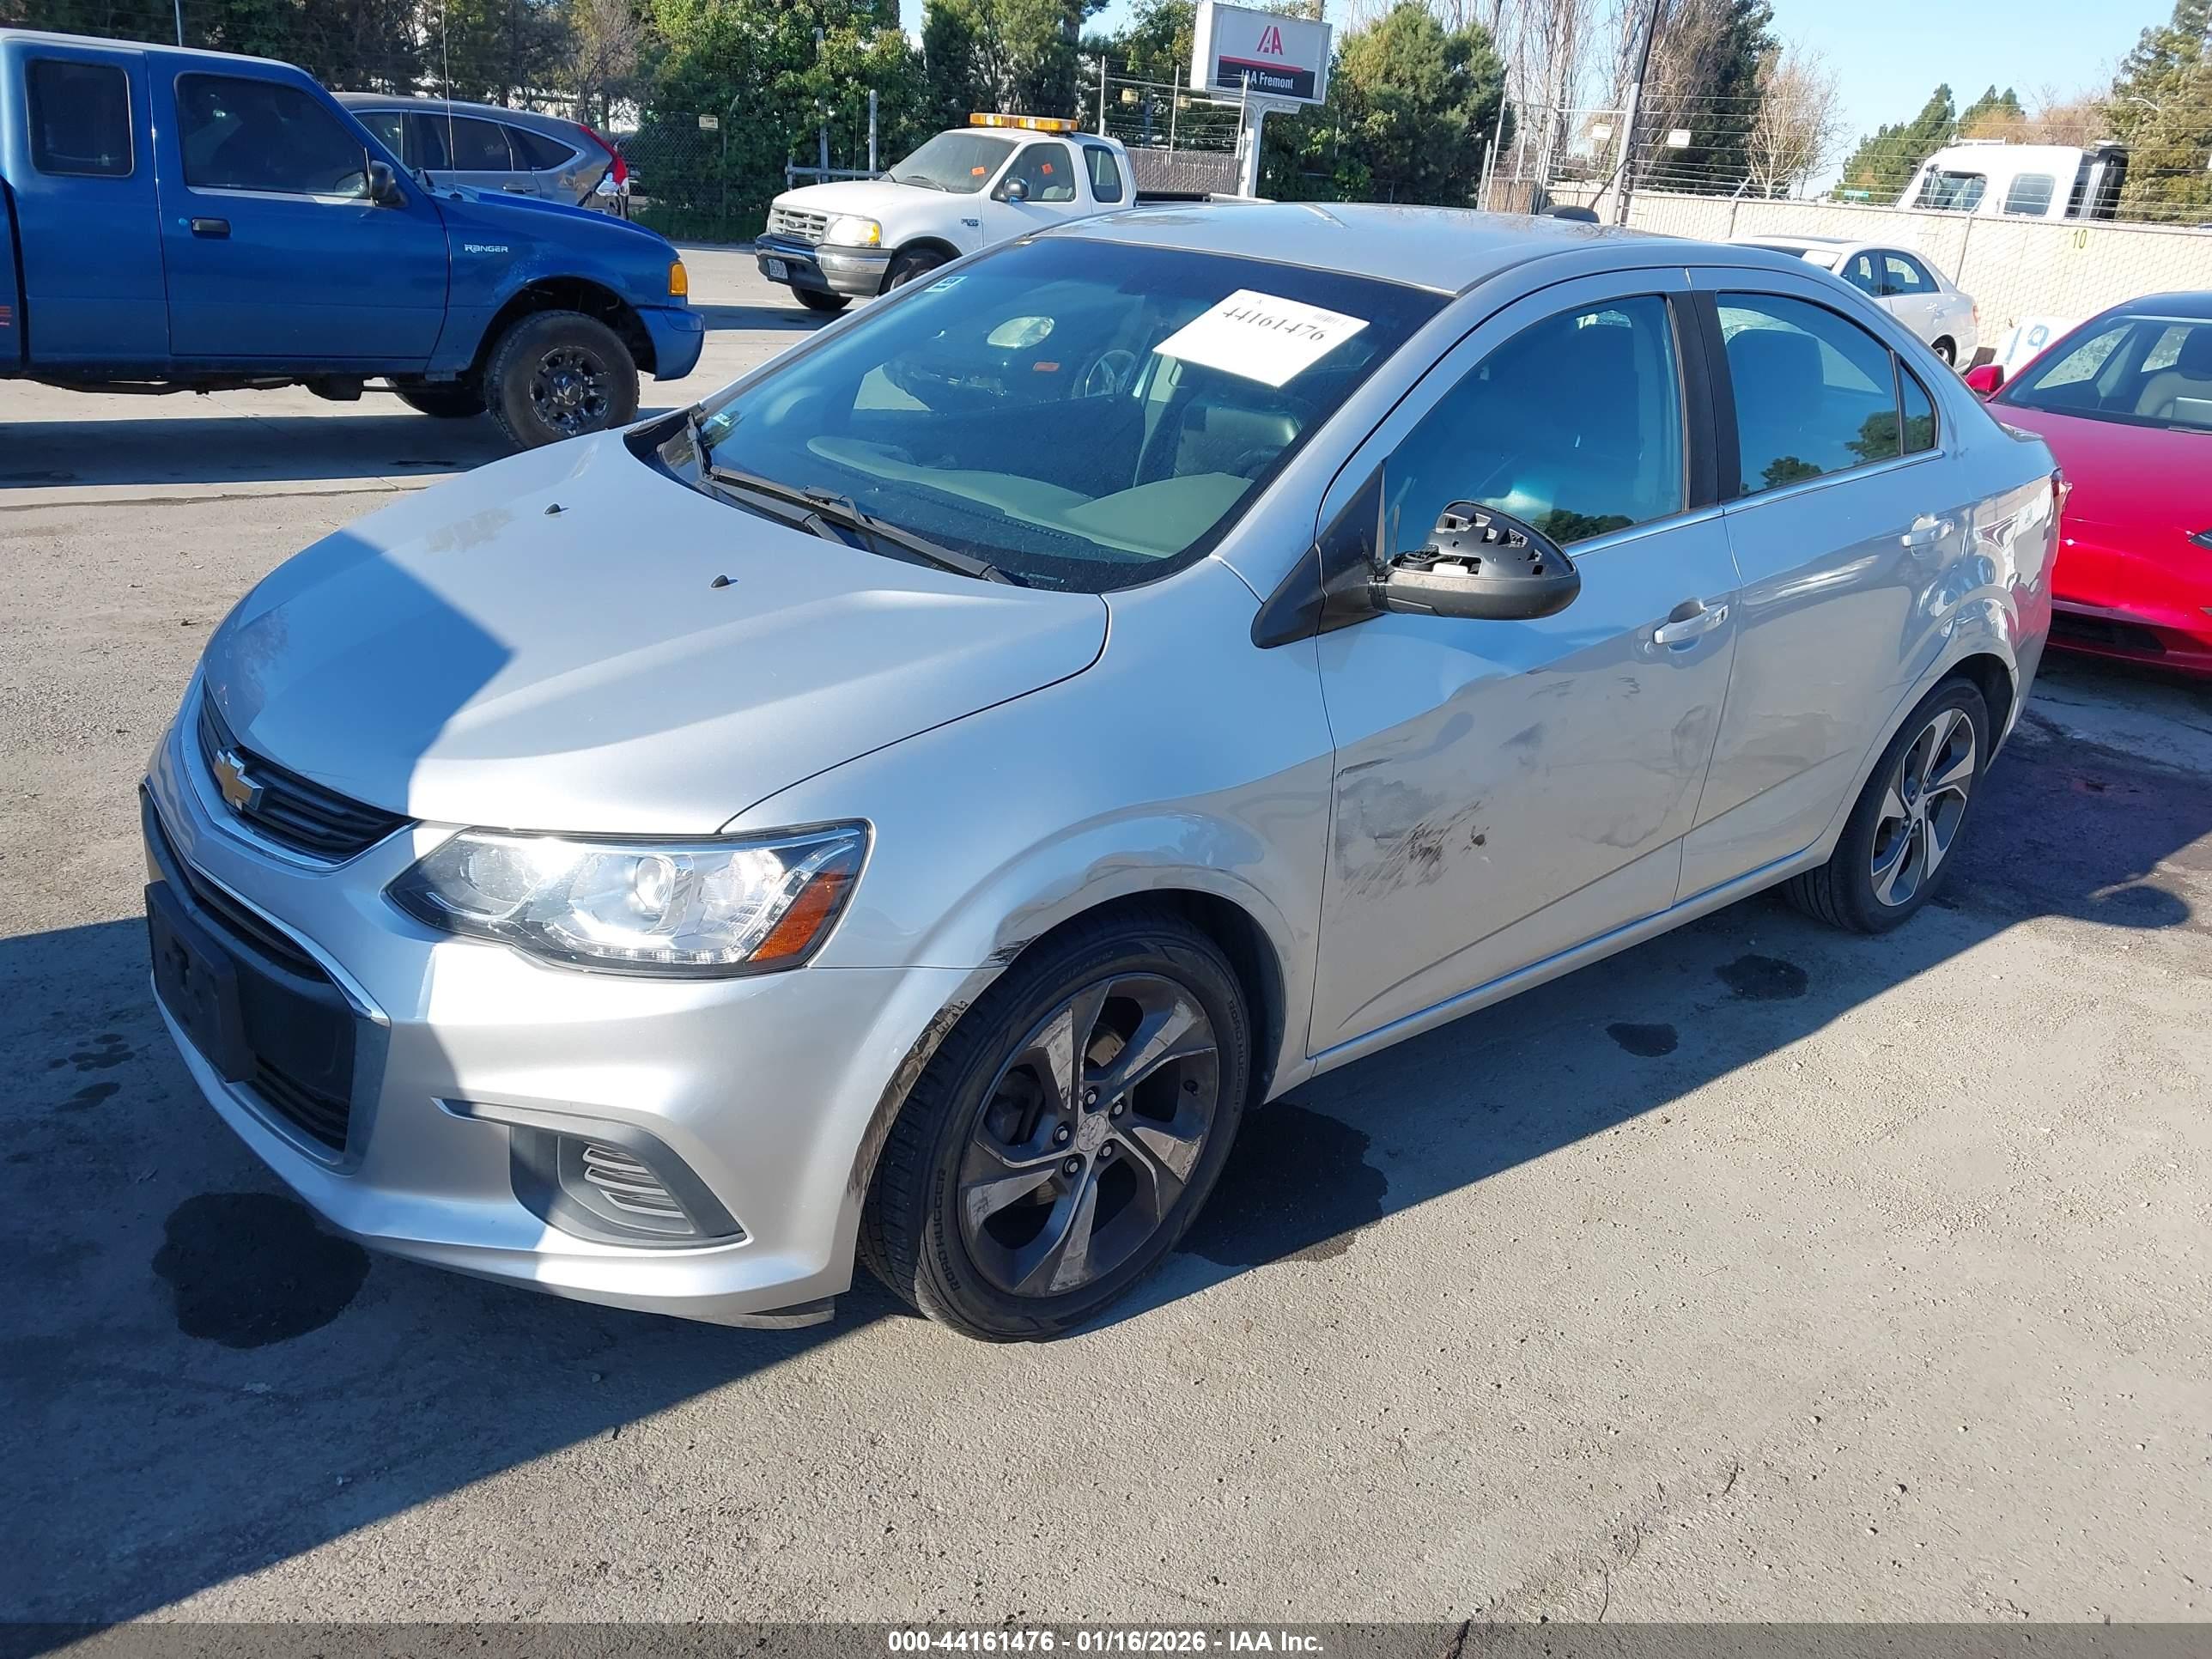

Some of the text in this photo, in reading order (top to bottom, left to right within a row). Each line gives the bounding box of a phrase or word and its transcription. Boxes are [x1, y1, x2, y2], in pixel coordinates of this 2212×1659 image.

[1260, 71, 1293, 90] Fremont
[464, 244, 508, 253] RANGER
[2073, 228, 2087, 249] 10
[1222, 307, 1328, 341] 44161476
[939, 1249, 962, 1293] ROAD
